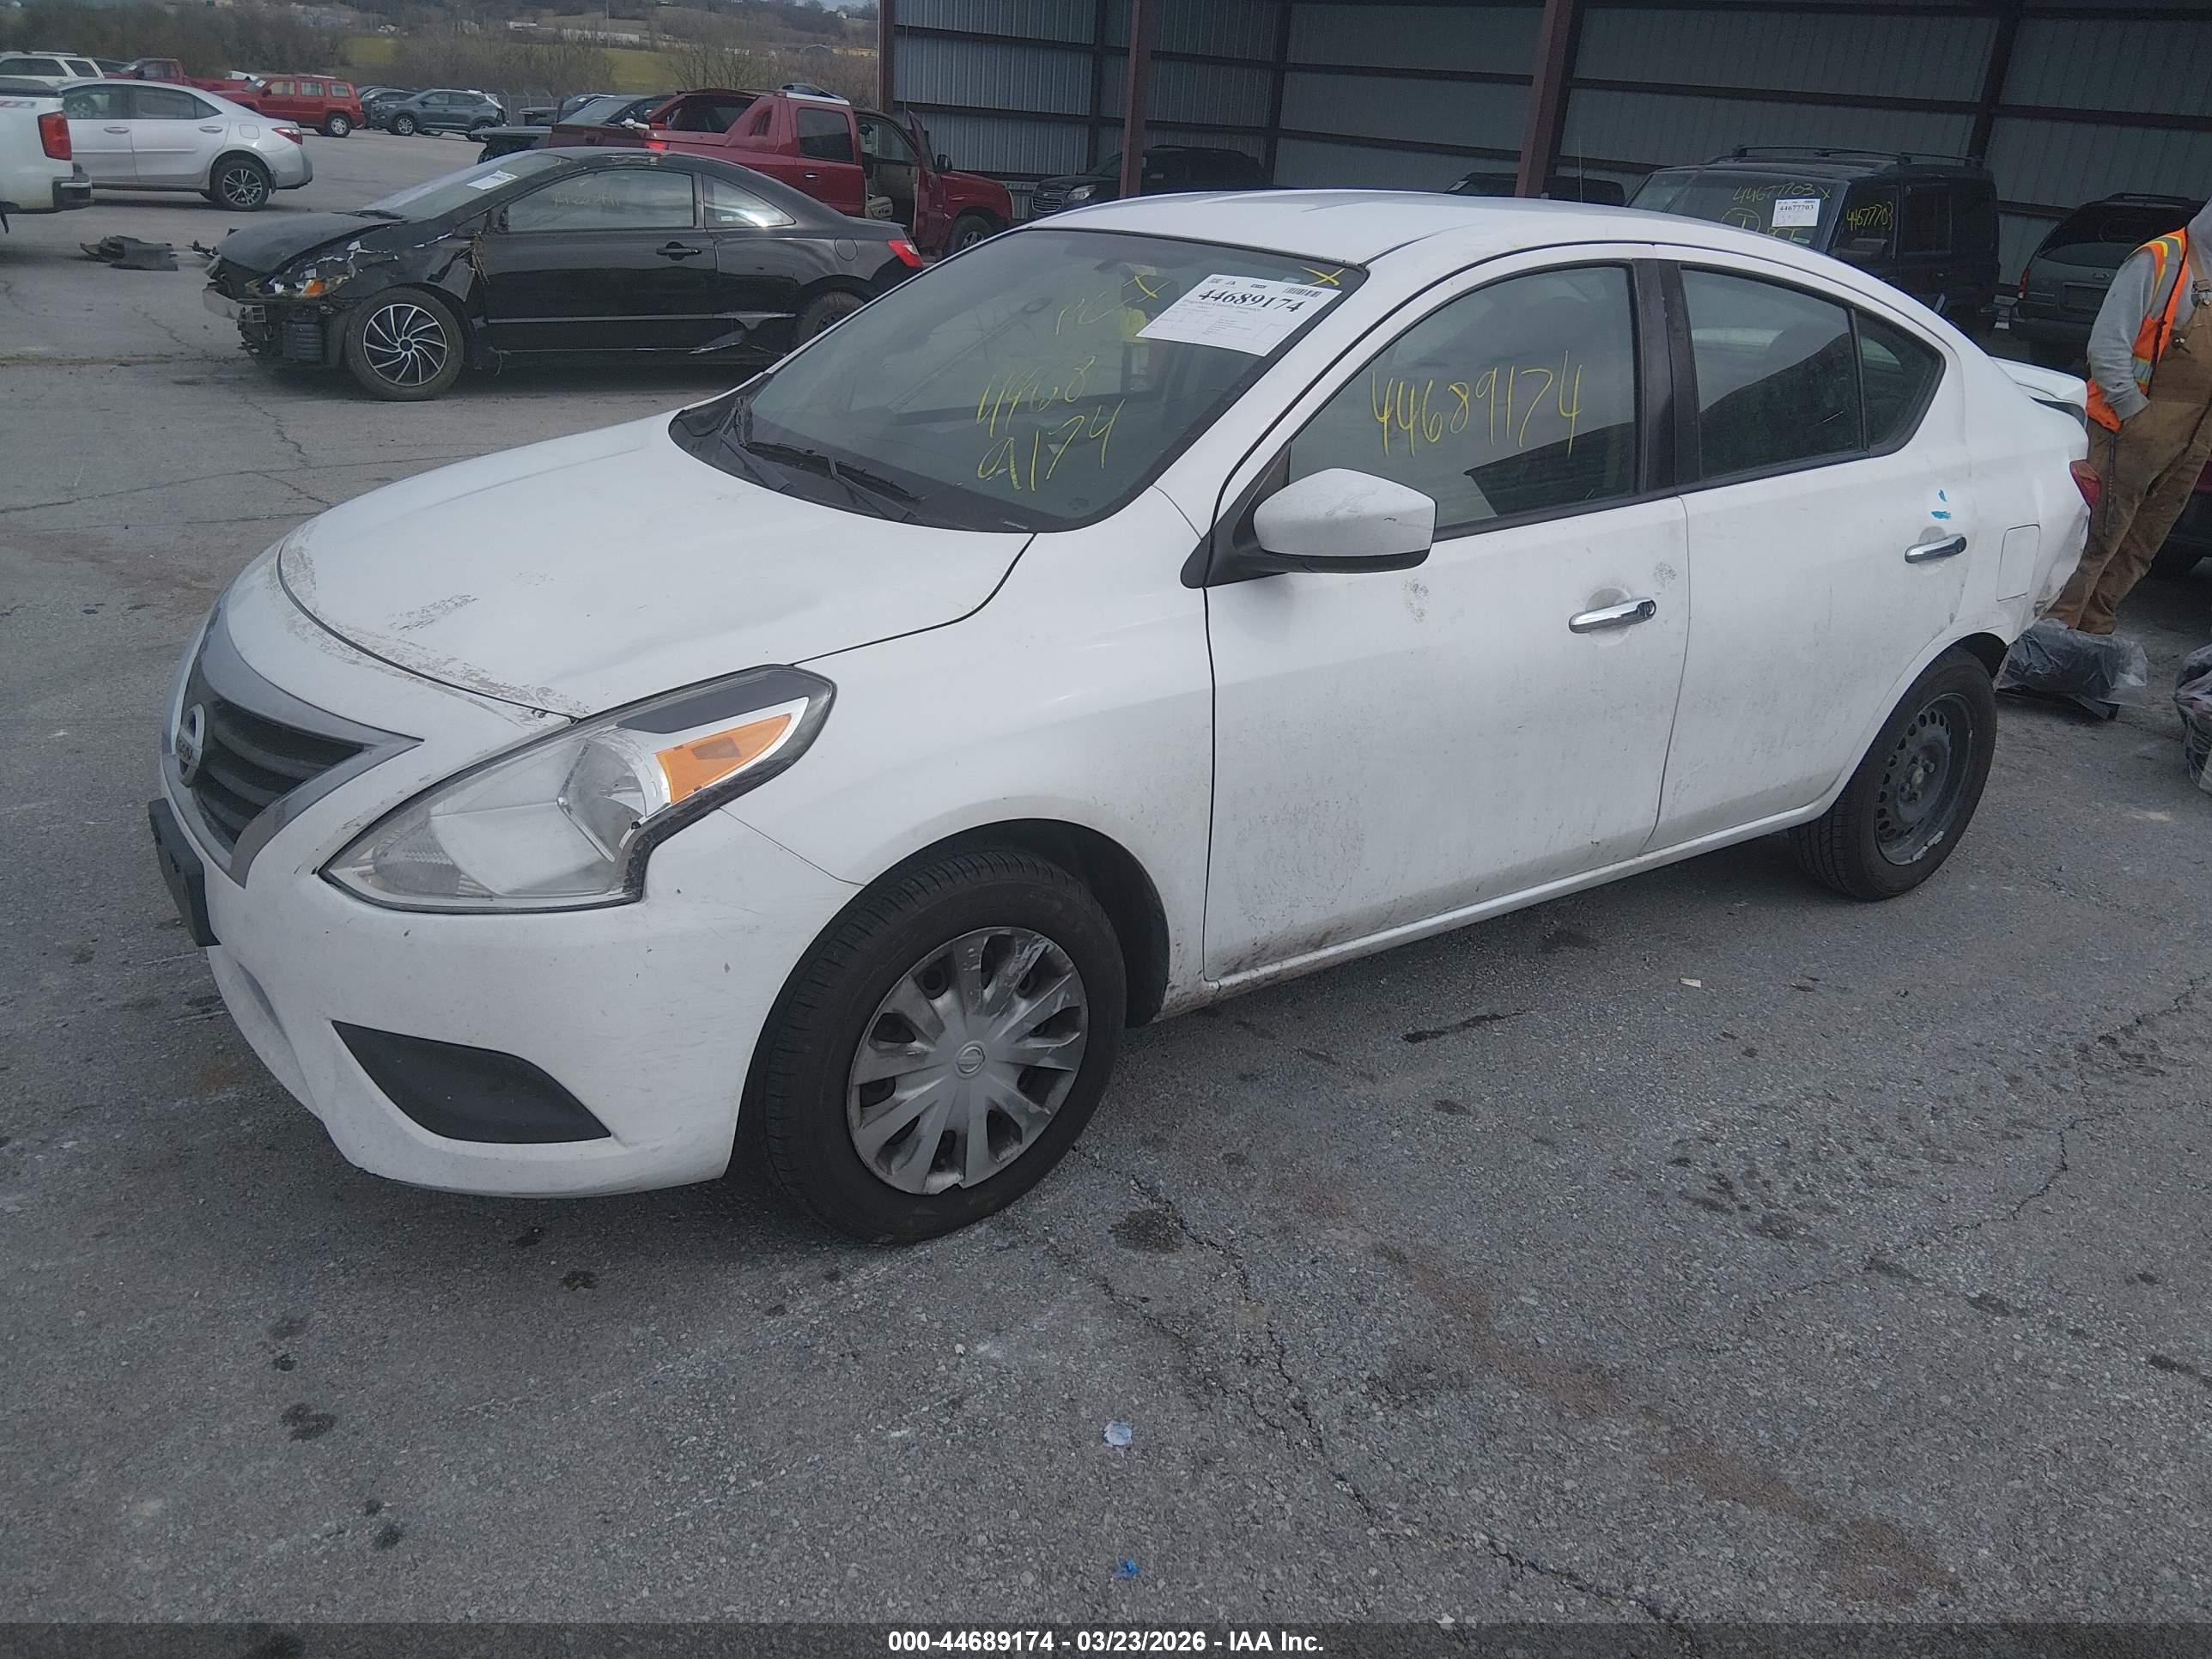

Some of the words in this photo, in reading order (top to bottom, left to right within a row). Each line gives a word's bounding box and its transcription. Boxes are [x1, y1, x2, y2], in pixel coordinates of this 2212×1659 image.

[1733, 182, 1815, 204] 44677703
[1847, 201, 1893, 231] 44677703
[1198, 289, 1306, 313] 44689174
[1371, 349, 1583, 458] 44689174
[977, 398, 1127, 492] 9174
